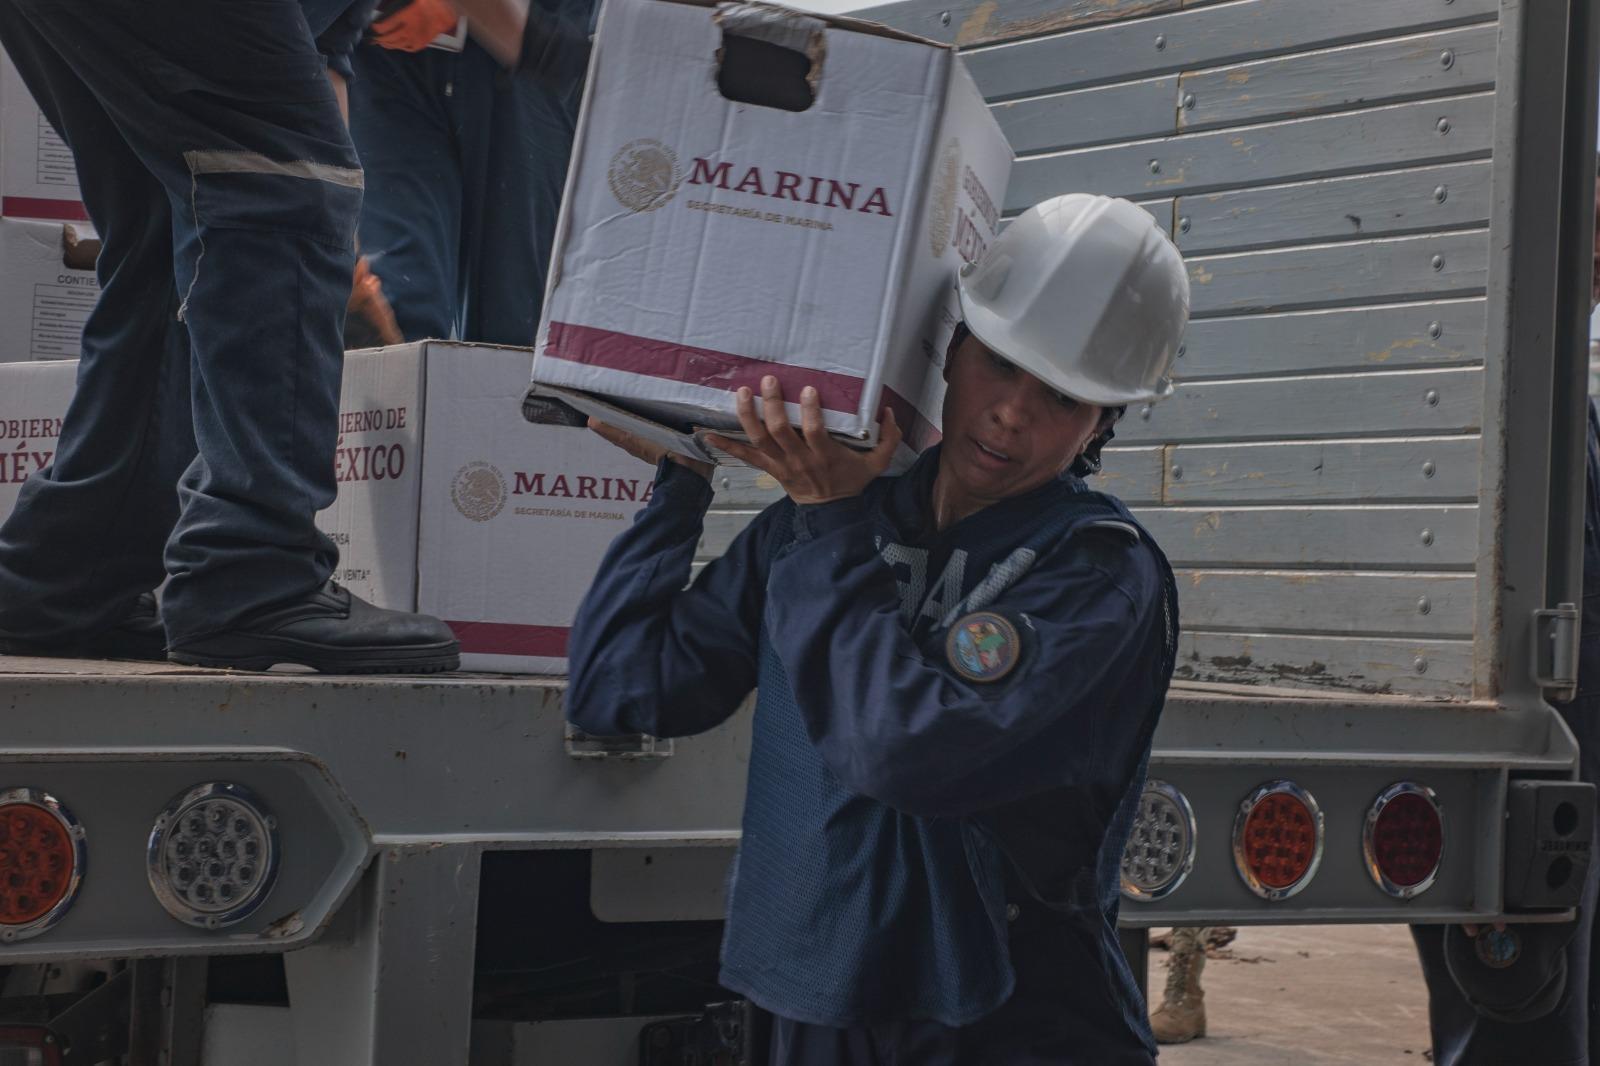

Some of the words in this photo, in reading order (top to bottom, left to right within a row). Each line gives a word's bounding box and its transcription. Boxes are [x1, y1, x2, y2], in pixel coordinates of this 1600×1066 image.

[687, 157, 893, 217] MARINA
[764, 212, 782, 223] DE
[784, 214, 833, 231] MARINA
[57, 274, 97, 286] CONTIE
[386, 407, 406, 429] DE
[514, 507, 572, 519] SECRETARÍA
[574, 511, 588, 519] DE
[589, 511, 625, 521] MARINA
